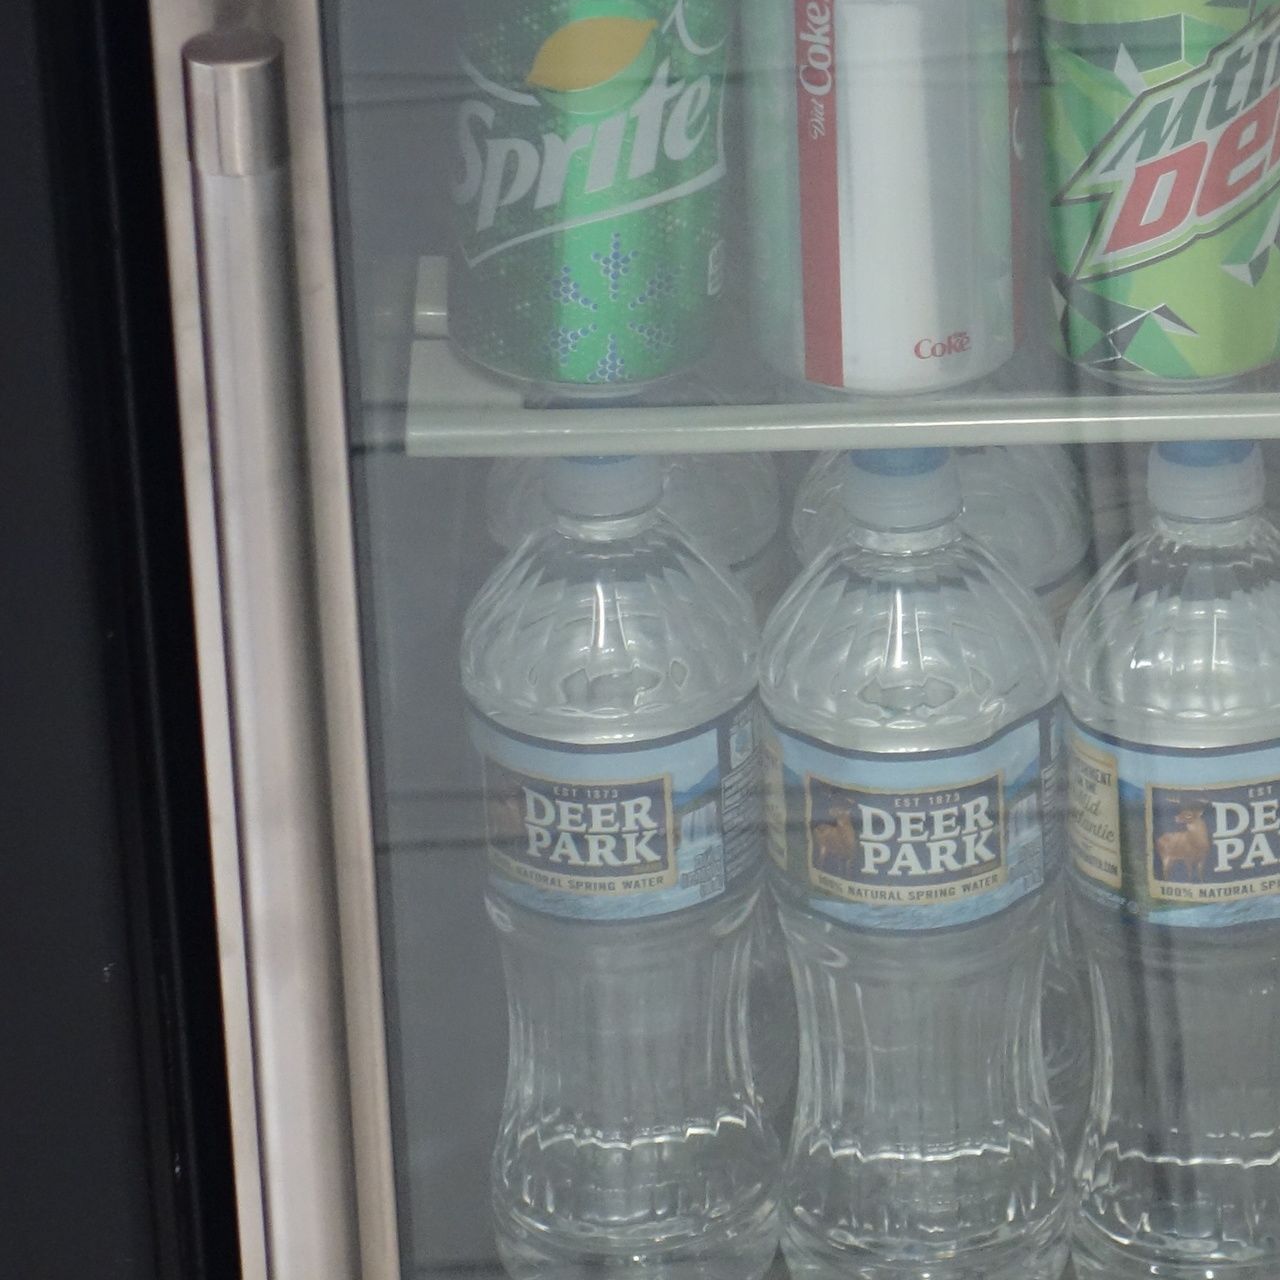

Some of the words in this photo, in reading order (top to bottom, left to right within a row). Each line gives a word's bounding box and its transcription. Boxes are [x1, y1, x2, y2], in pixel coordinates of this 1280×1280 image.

[799, 1, 832, 96] Coke
[809, 98, 826, 140] Diet
[451, 56, 711, 233] Sprite
[914, 332, 971, 360] Coke
[522, 785, 658, 833] DEER
[553, 786, 578, 798] EST
[893, 796, 920, 808] EST
[928, 793, 961, 806] 1873
[1248, 786, 1273, 798] EST
[859, 795, 994, 842] DEER
[524, 823, 661, 866] PARK
[860, 829, 996, 876] PARK
[568, 879, 616, 891] SPRING
[622, 876, 665, 890] WATER
[848, 885, 903, 901] NATURAL
[908, 886, 955, 900] SPRING
[962, 874, 998, 893] WATER
[1160, 885, 1193, 898] 100%
[1199, 885, 1255, 898] NATURAL
